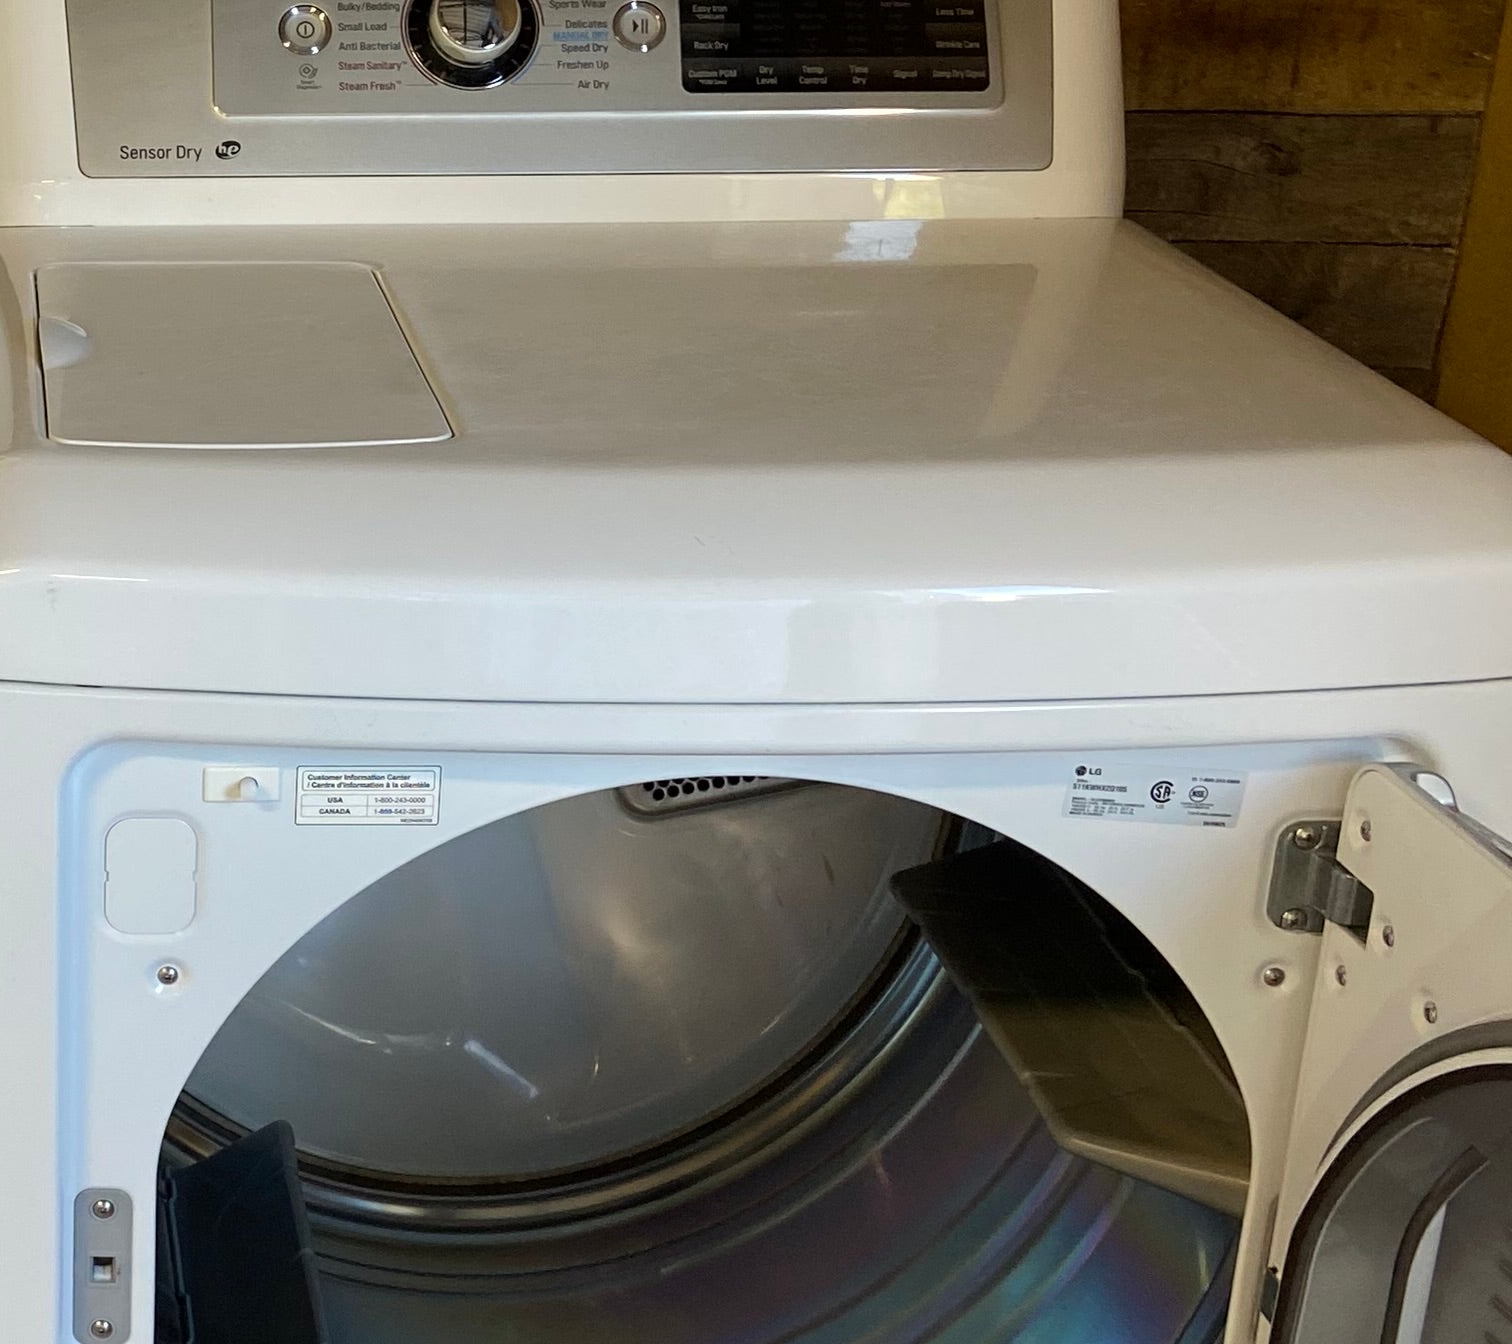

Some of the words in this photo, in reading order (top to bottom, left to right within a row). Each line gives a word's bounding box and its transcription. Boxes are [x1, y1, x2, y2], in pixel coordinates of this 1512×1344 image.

[337, 2, 401, 13] Bulky/Bedding
[548, 0, 580, 10] Sports
[581, 0, 607, 9] Wear
[337, 22, 363, 32] Small
[364, 22, 388, 32] Load
[564, 19, 609, 29] Delicates
[338, 41, 358, 51] Anti
[359, 41, 402, 51] Bacterial
[560, 43, 591, 53] Speed
[592, 43, 609, 54] Dry
[337, 61, 365, 71] Steam
[556, 60, 594, 70] Freshen
[595, 60, 609, 71] Up
[338, 82, 369, 91] Steam
[577, 79, 592, 89] Air
[593, 79, 610, 90] Dry
[119, 145, 173, 160] Sensor
[175, 144, 203, 162] Dry
[307, 773, 343, 781] Customer
[343, 773, 386, 781] Information
[386, 773, 412, 781] Center
[1088, 768, 1102, 776] LG
[311, 781, 335, 789] Centre
[336, 781, 385, 789] d'information
